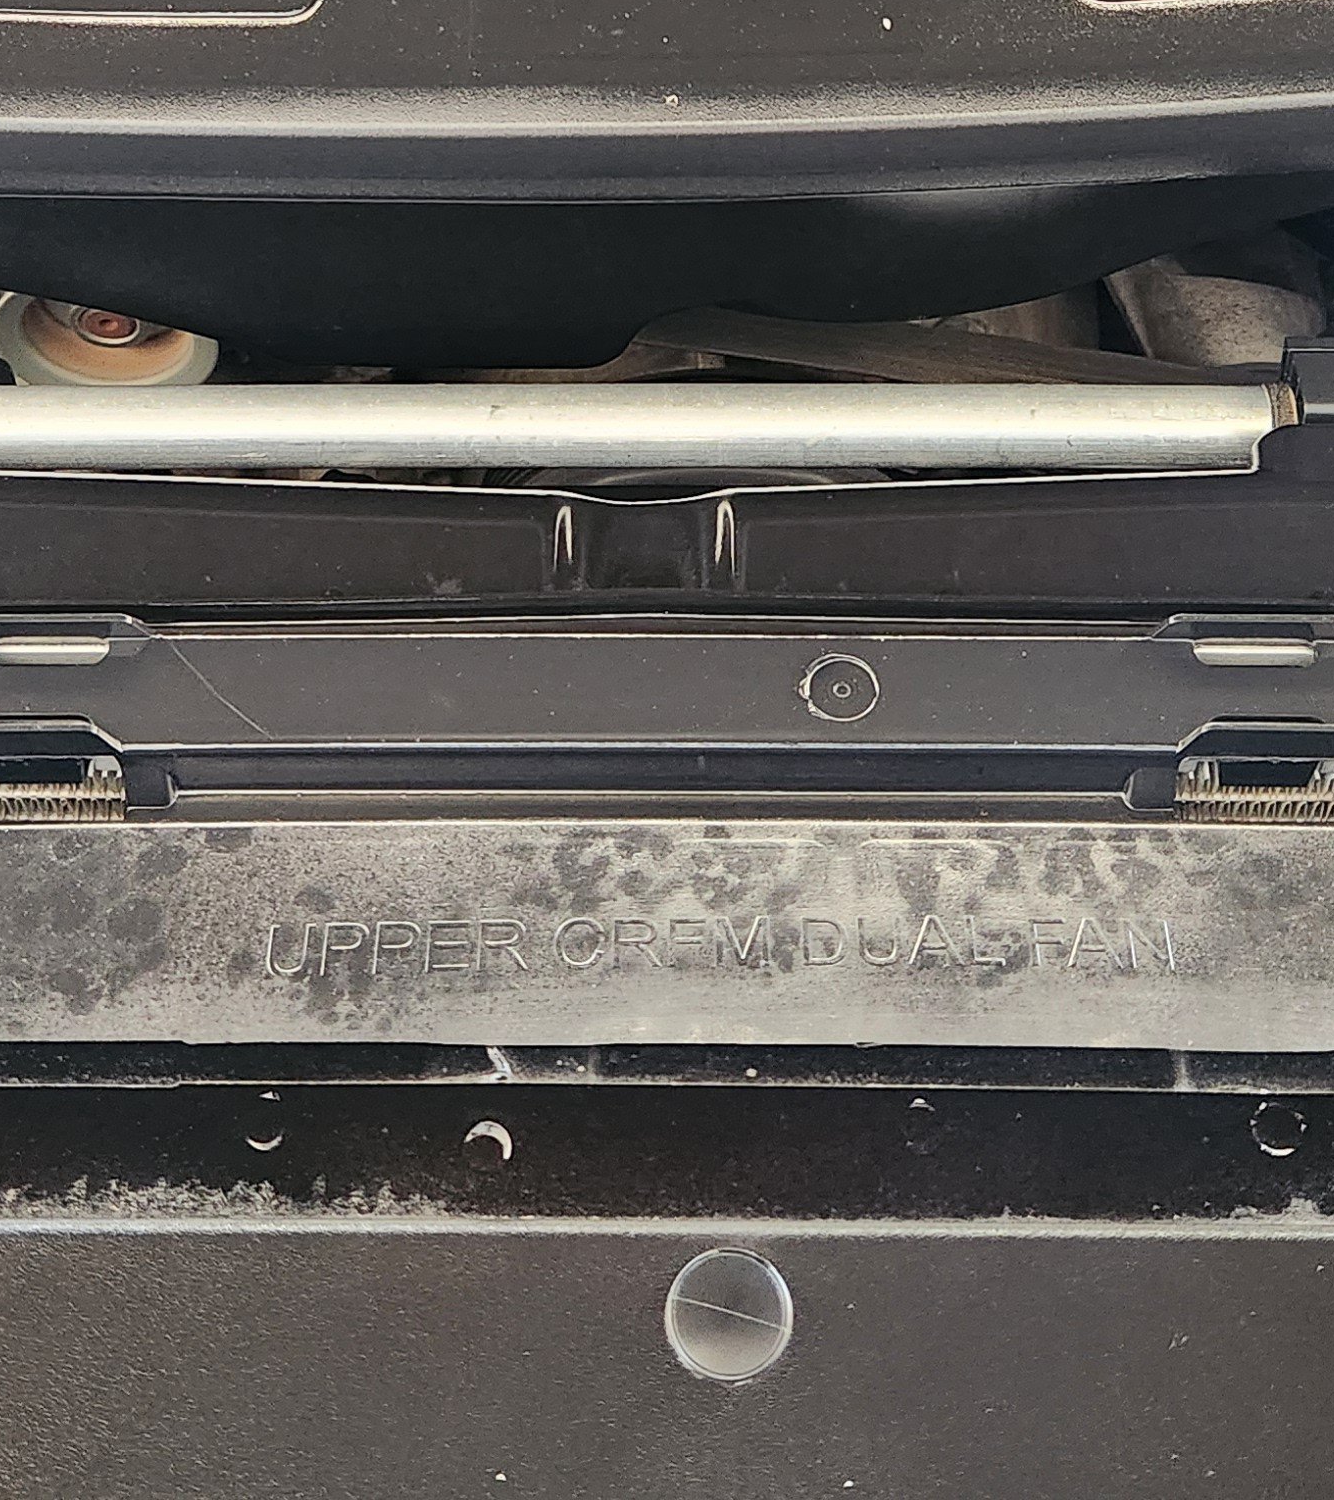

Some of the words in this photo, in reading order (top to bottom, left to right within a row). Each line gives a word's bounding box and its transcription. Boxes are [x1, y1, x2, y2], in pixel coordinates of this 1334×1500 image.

[265, 918, 529, 977] UPPER
[553, 914, 770, 970] CRFM
[801, 913, 1007, 968] DUAL
[1030, 915, 1175, 971] FAN
